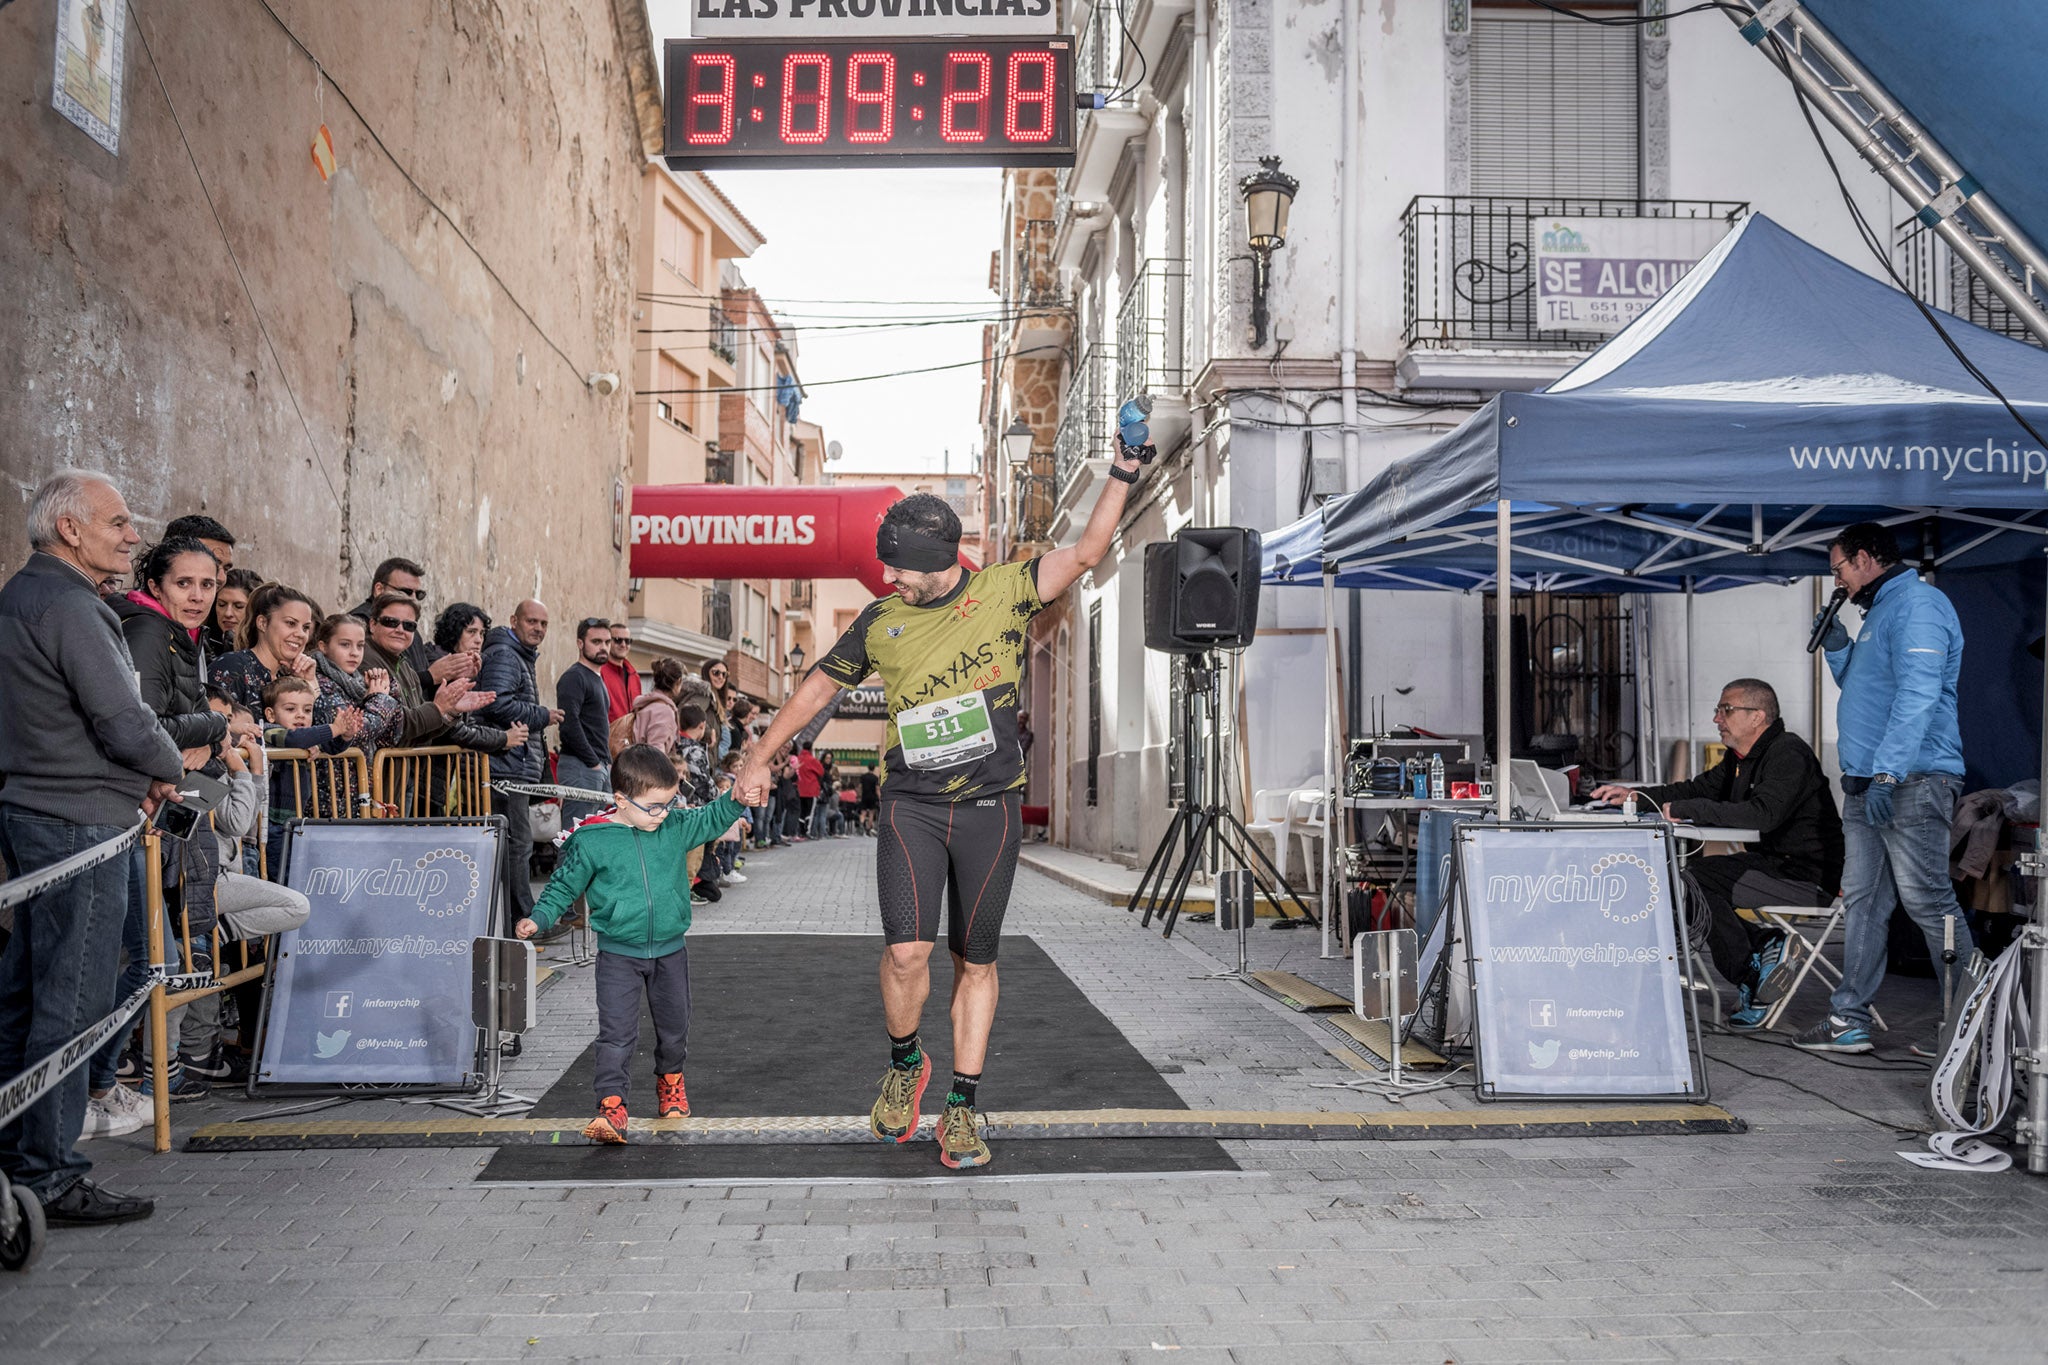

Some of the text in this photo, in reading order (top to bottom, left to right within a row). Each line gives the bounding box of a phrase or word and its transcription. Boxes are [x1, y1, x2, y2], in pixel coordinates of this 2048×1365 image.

[1545, 261, 1694, 298] SE ALQU
[1789, 438, 2048, 483] www.mychip
[630, 514, 815, 546] PROVINCIAS
[973, 665, 1002, 691] CLUB
[924, 716, 964, 740] 511
[305, 858, 449, 905] mychip
[1486, 865, 1628, 911] mychip
[296, 934, 470, 959] www.mychip.es
[1490, 943, 1661, 967] www.mychip.es
[362, 997, 420, 1008] /infomychip
[1566, 1007, 1624, 1019] /infomychip
[356, 1037, 428, 1049] @Mychip_Info
[1568, 1049, 1640, 1060] @Mychip_Info
